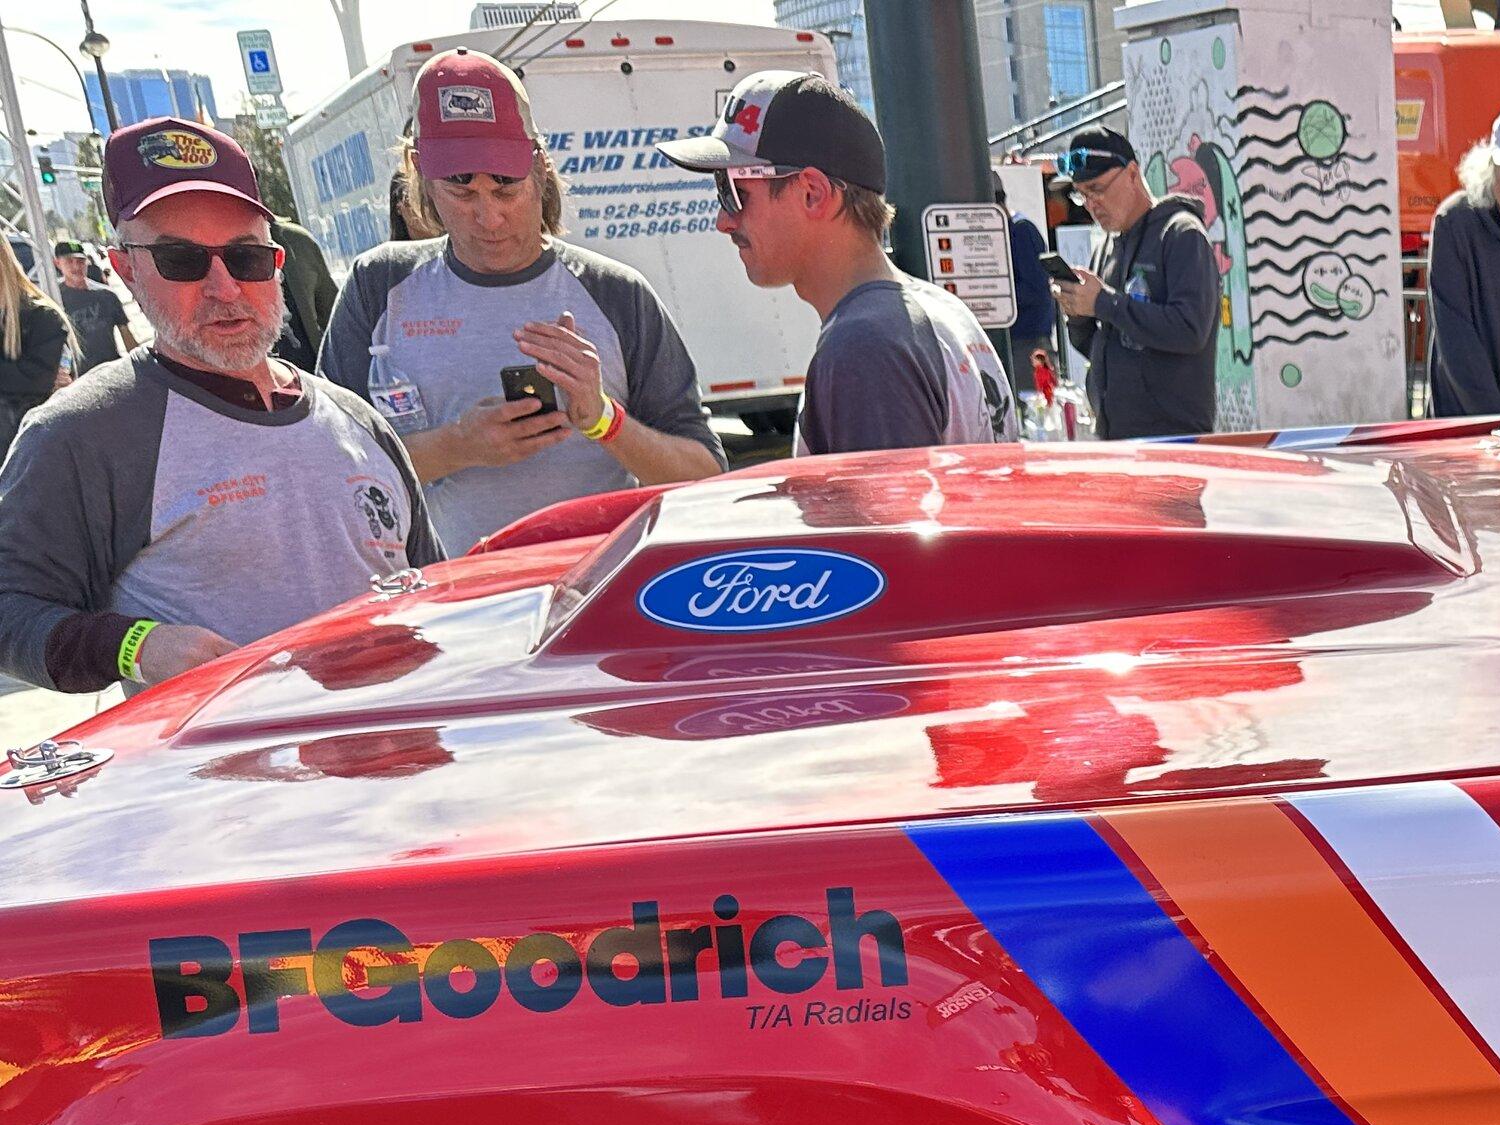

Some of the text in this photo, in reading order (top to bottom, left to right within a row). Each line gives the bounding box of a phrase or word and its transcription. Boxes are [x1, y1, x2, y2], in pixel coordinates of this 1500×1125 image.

[725, 95, 761, 134] U4
[172, 135, 201, 146] The
[583, 125, 678, 150] WATER
[559, 153, 625, 174] AND
[688, 560, 832, 618] Ford
[148, 887, 910, 1041] BFGoodrich
[745, 998, 912, 1030] T/A Radials
